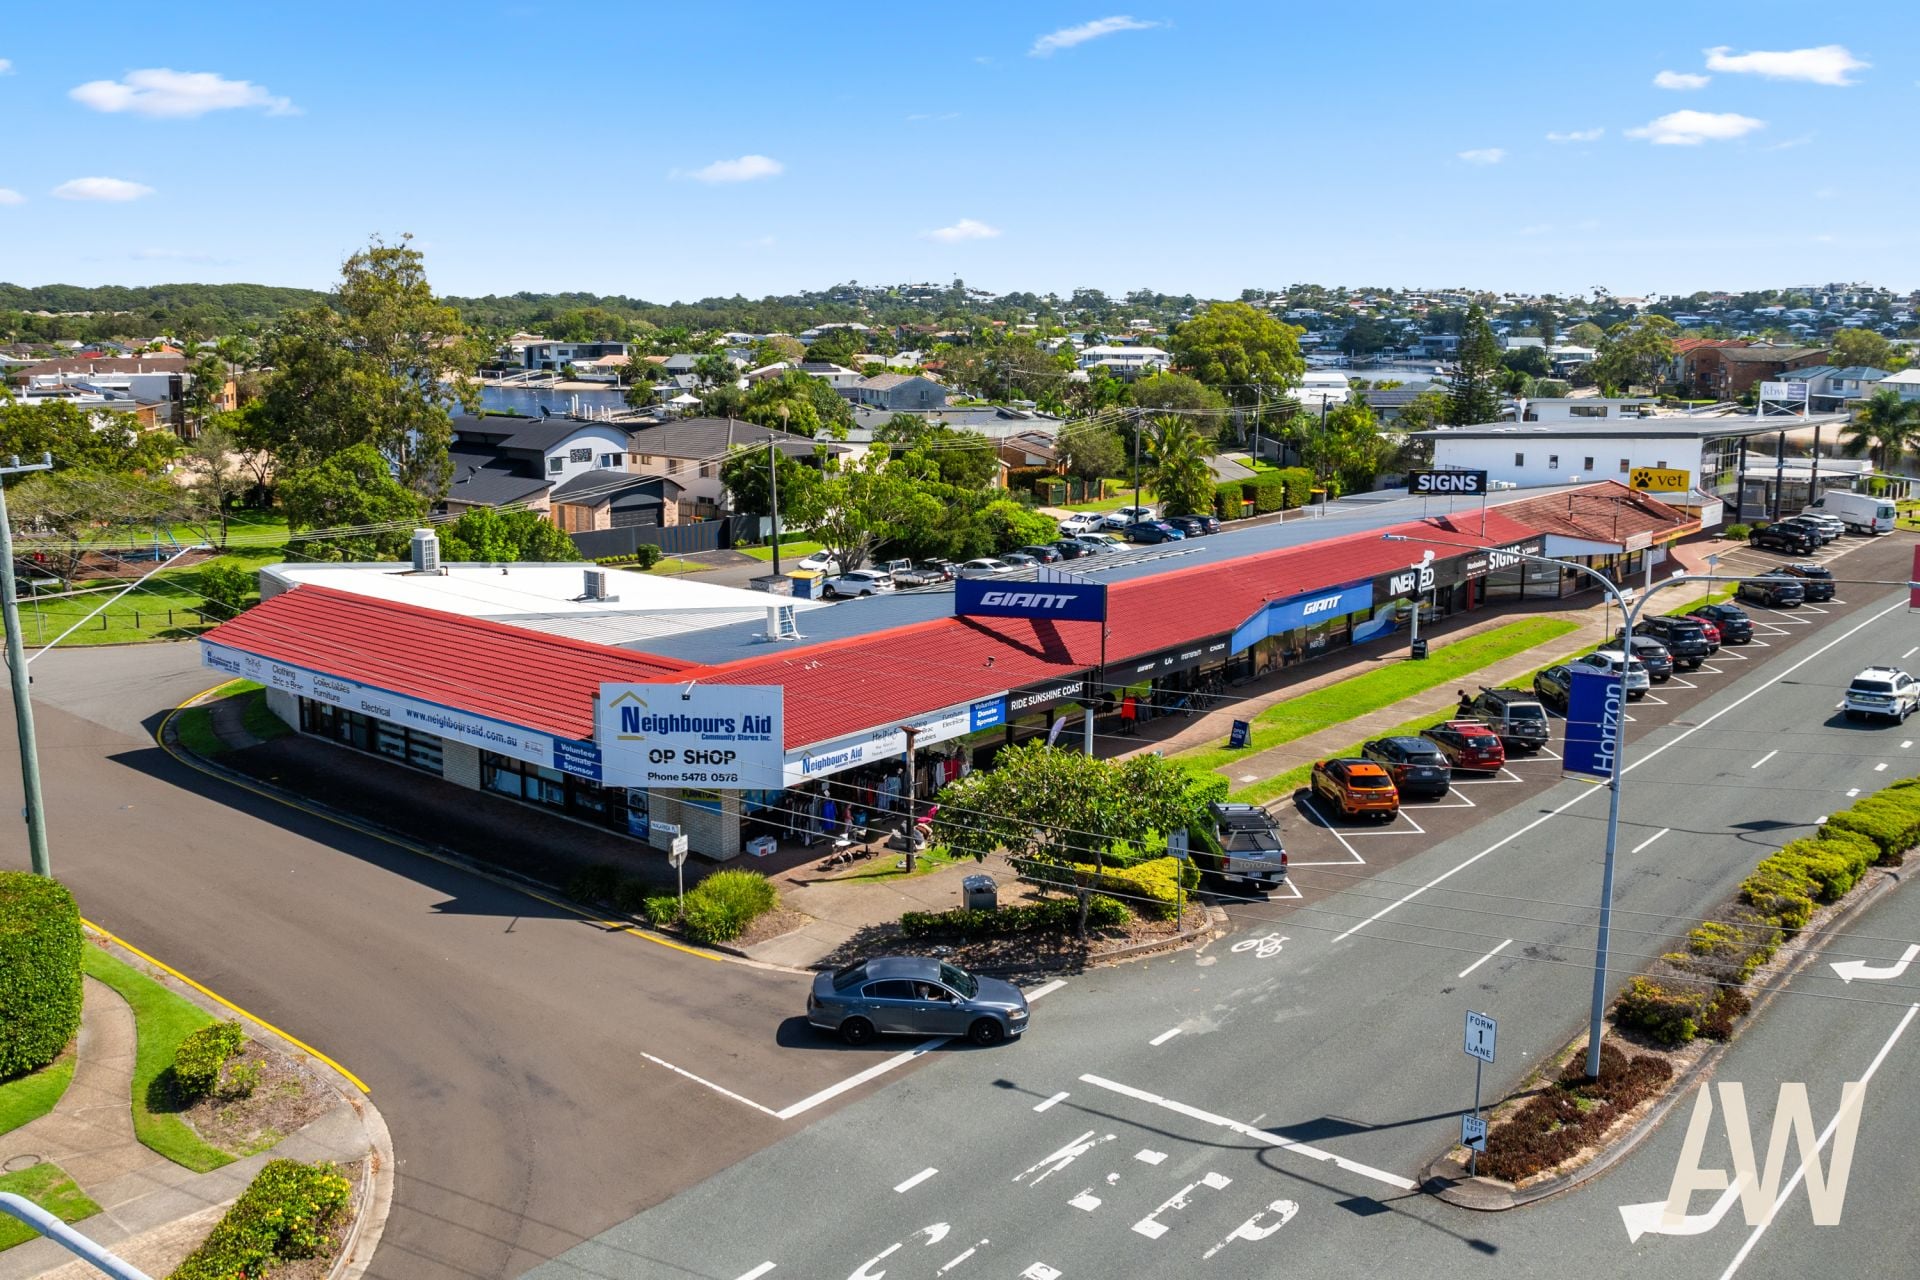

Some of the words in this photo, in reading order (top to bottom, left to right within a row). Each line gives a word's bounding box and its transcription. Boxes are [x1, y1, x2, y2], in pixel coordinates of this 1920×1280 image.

[1417, 474, 1478, 491] SIGNS
[1657, 474, 1683, 487] vet
[1489, 545, 1520, 570] SIGNS
[980, 591, 1079, 609] GIANT
[1303, 594, 1343, 616] GIANT
[272, 665, 296, 680] Clothing
[313, 677, 350, 694] Collectables
[313, 687, 341, 702] Furniture
[1011, 698, 1028, 711] RIDE
[1028, 688, 1062, 706] SUNSHINE
[1062, 682, 1084, 696] COAST
[361, 700, 391, 717] Electrical
[975, 700, 1000, 710] Volunteer
[621, 706, 736, 735] Neighbours
[742, 715, 772, 734] Aid
[977, 708, 998, 718] Donate
[406, 708, 518, 747] www.neighboursaid.com.au
[1593, 683, 1621, 772] Horizon
[701, 733, 736, 742] Community
[561, 743, 596, 759] Volunteer
[649, 749, 676, 764] OP
[683, 749, 736, 764] SHOP
[565, 754, 592, 766] Donate
[802, 752, 849, 775] Neighbours
[851, 747, 863, 760] Aid
[563, 762, 594, 776] Sponsor
[647, 772, 680, 782] Phone
[681, 772, 707, 782] 5478
[711, 773, 738, 783] 0578
[1239, 860, 1273, 869] TOYOTA
[1469, 1016, 1493, 1031] FORM
[1478, 1030, 1483, 1044] 1
[1468, 1043, 1491, 1058] LANE
[1466, 1118, 1483, 1127] KEEP
[1466, 1125, 1482, 1134] LEFT
